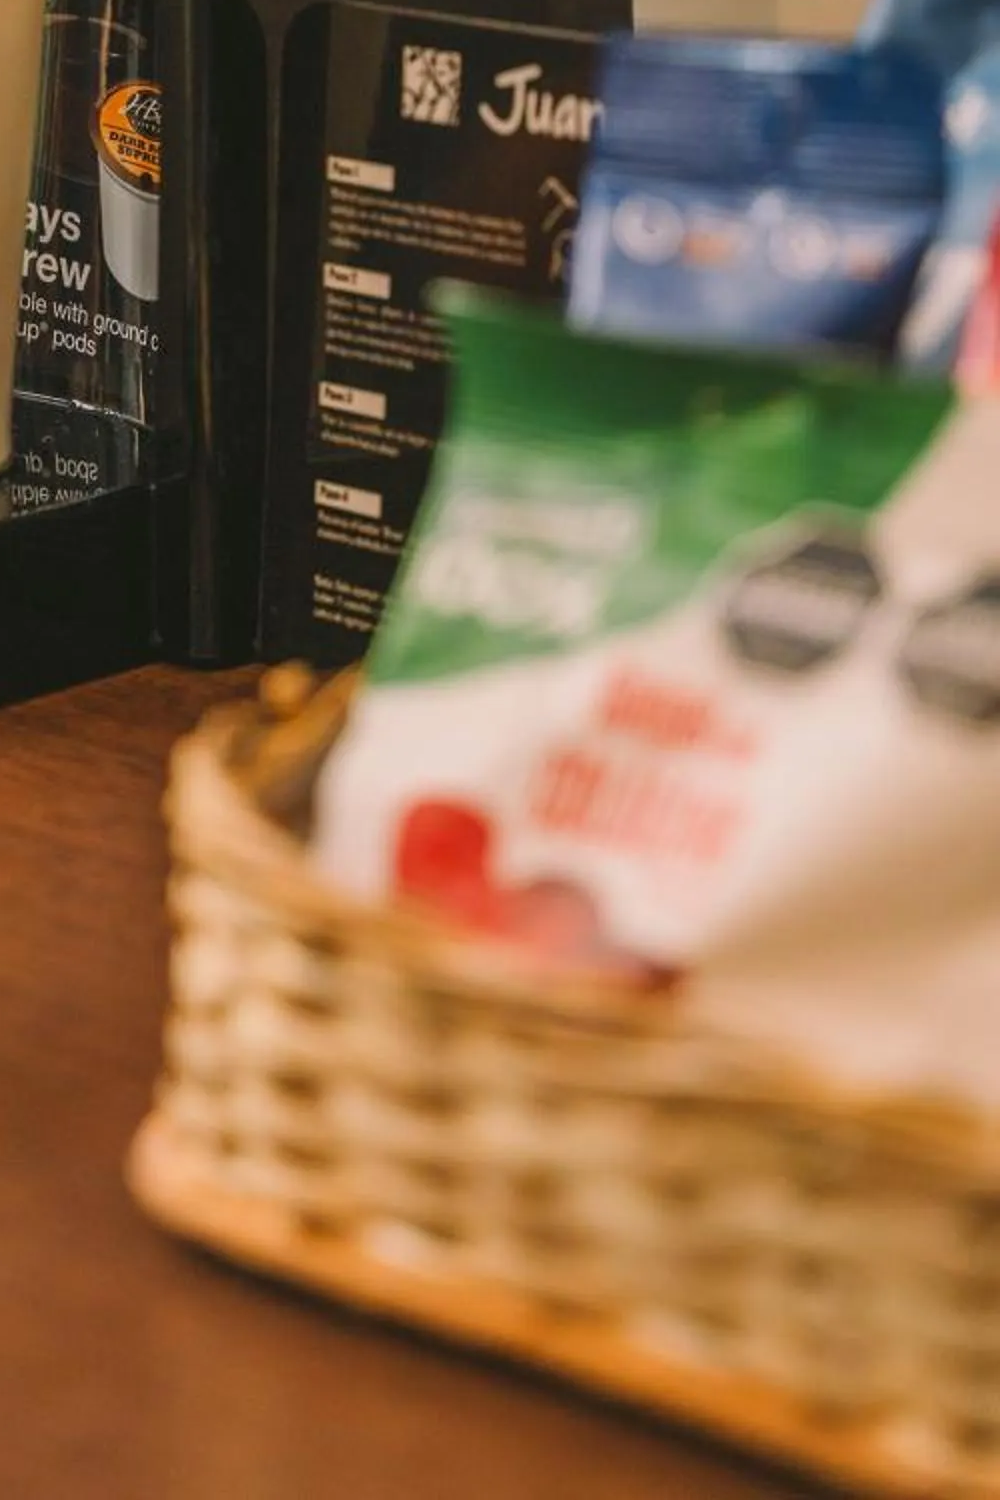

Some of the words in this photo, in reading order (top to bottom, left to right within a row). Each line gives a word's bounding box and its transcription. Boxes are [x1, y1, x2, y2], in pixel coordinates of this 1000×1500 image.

[25, 202, 82, 243] ays
[22, 249, 91, 291] rew
[20, 290, 48, 315] ble
[53, 300, 89, 327] with
[94, 313, 149, 347] ground
[53, 328, 98, 357] pods
